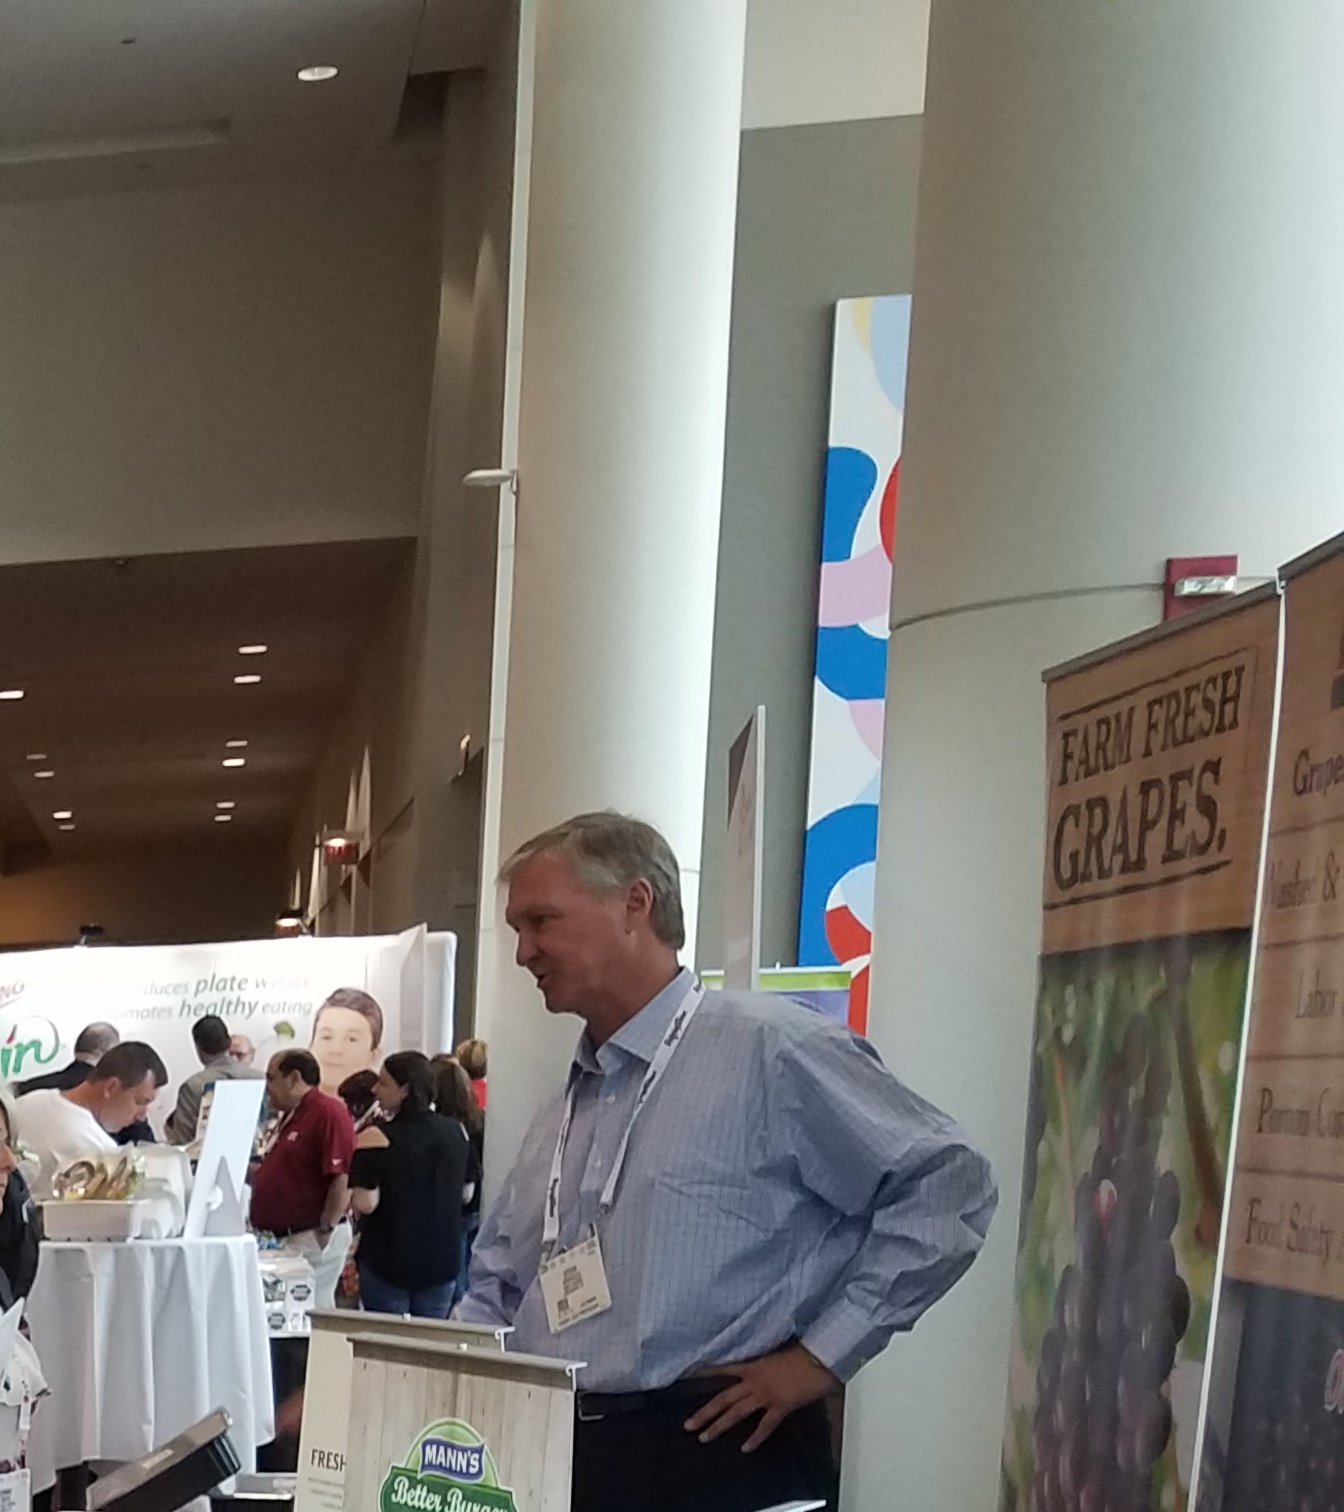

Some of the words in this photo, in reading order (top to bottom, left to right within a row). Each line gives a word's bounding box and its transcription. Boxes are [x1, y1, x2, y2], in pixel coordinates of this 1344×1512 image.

[1057, 705, 1137, 786] FARM
[1142, 664, 1246, 759] FRESH
[1052, 757, 1227, 892] GRAPES.
[194, 972, 249, 998] plate
[179, 995, 260, 1020] healthy
[262, 999, 312, 1017] eating
[423, 1443, 481, 1475] MANN'S
[391, 1478, 444, 1512] Better
